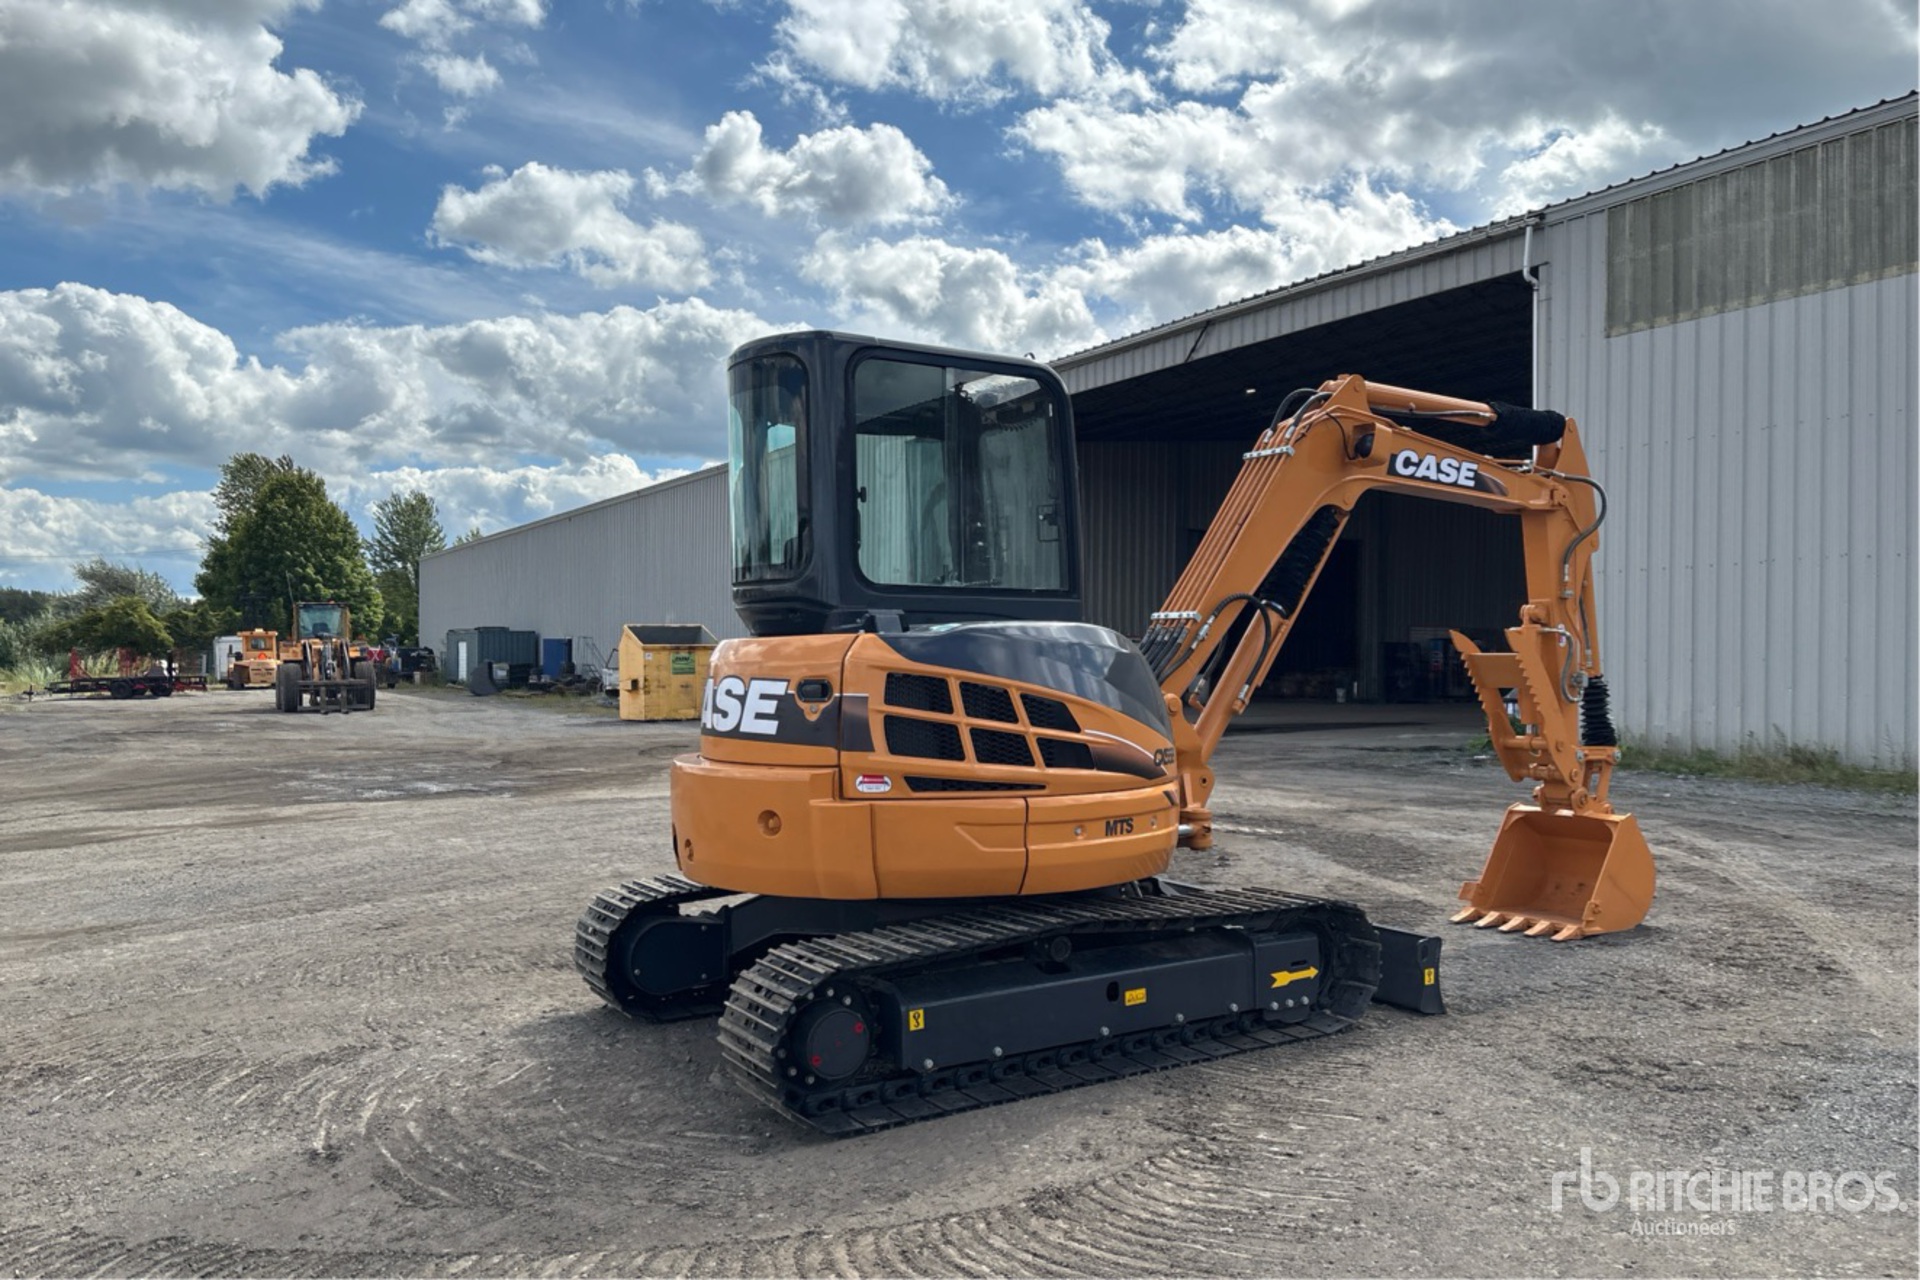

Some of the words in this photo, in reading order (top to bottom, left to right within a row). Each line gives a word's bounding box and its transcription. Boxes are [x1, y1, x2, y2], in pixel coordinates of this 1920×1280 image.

[1395, 449, 1478, 487] CASE
[701, 677, 788, 735] ASE
[1105, 817, 1134, 836] MTS
